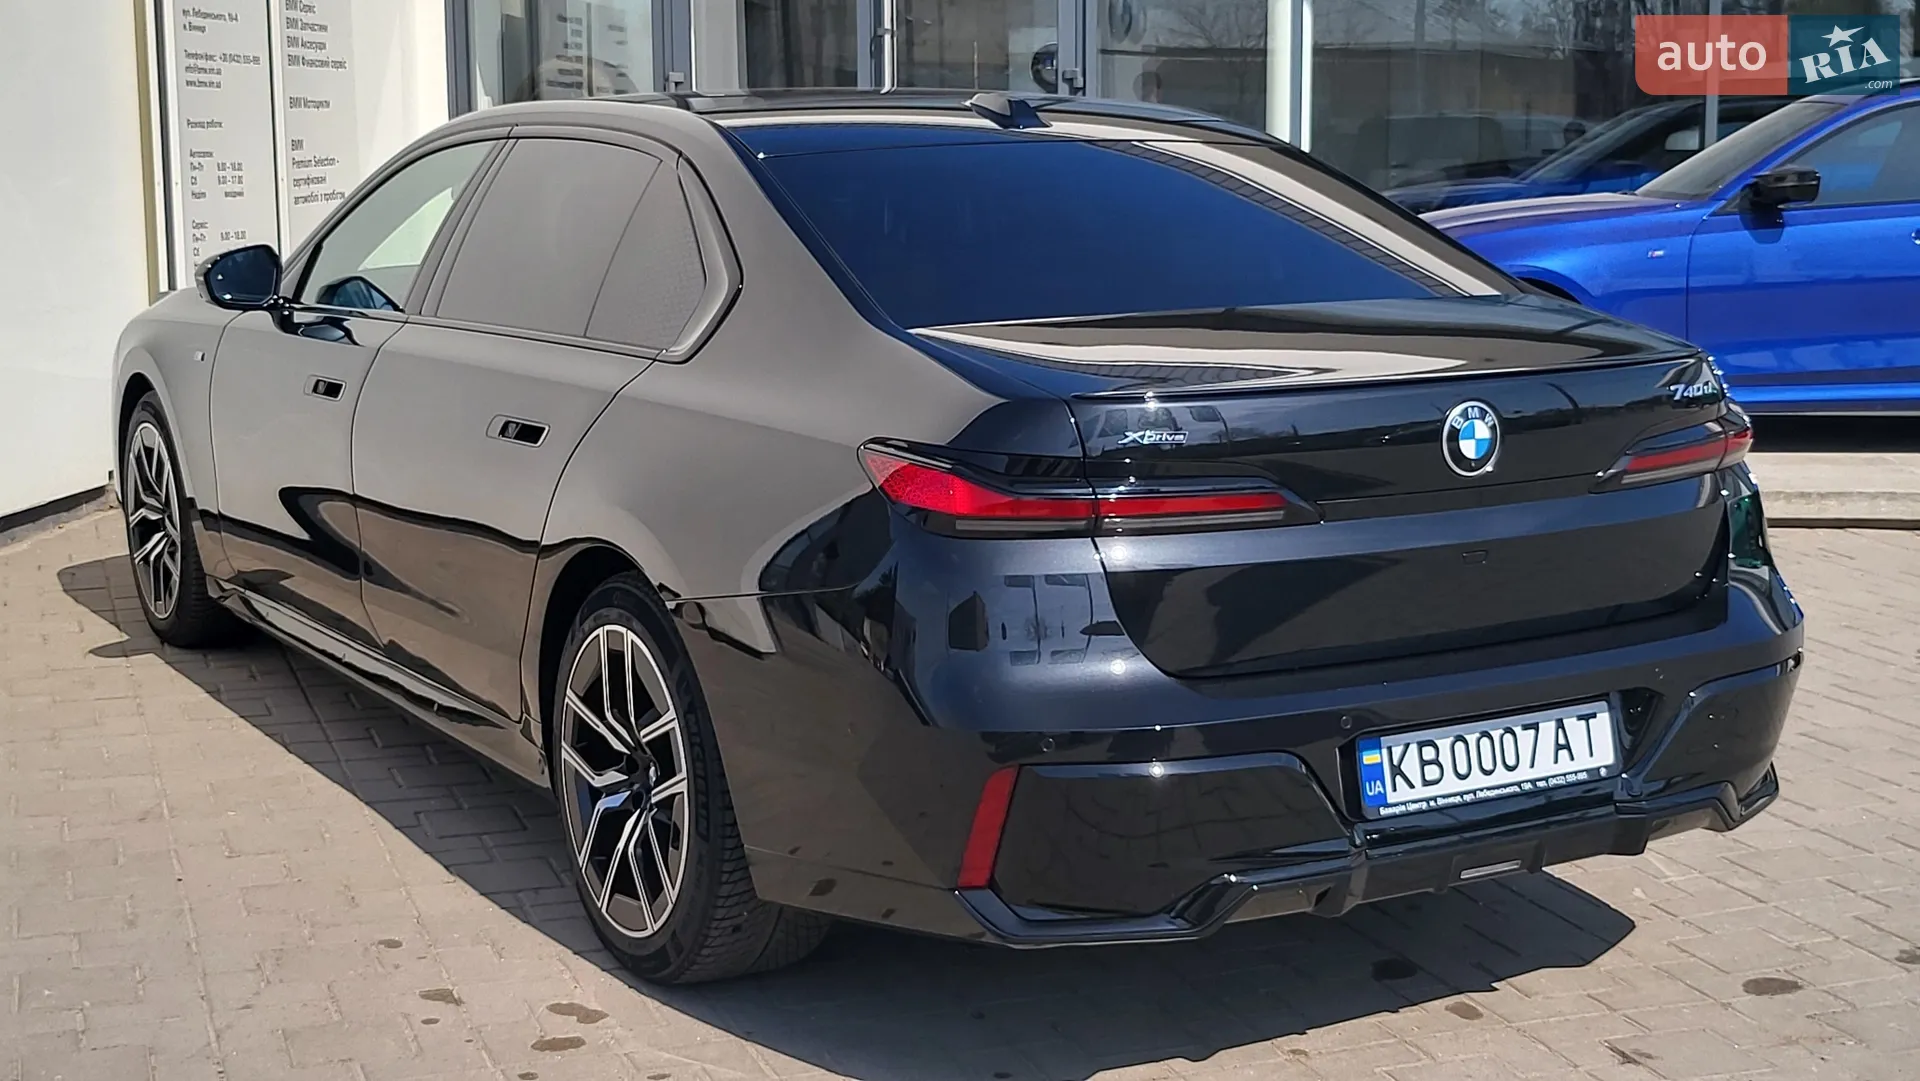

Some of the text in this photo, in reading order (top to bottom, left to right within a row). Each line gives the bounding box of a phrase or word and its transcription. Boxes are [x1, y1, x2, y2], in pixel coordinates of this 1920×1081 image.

[286, 17, 299, 29] BMW
[286, 36, 300, 48] BMW
[287, 54, 301, 67] BMW
[289, 96, 302, 109] BMW
[291, 139, 304, 151] BMW
[292, 156, 313, 169] Premium
[313, 155, 336, 168] Selection
[1451, 406, 1495, 430] BMW
[1365, 780, 1385, 797] UA
